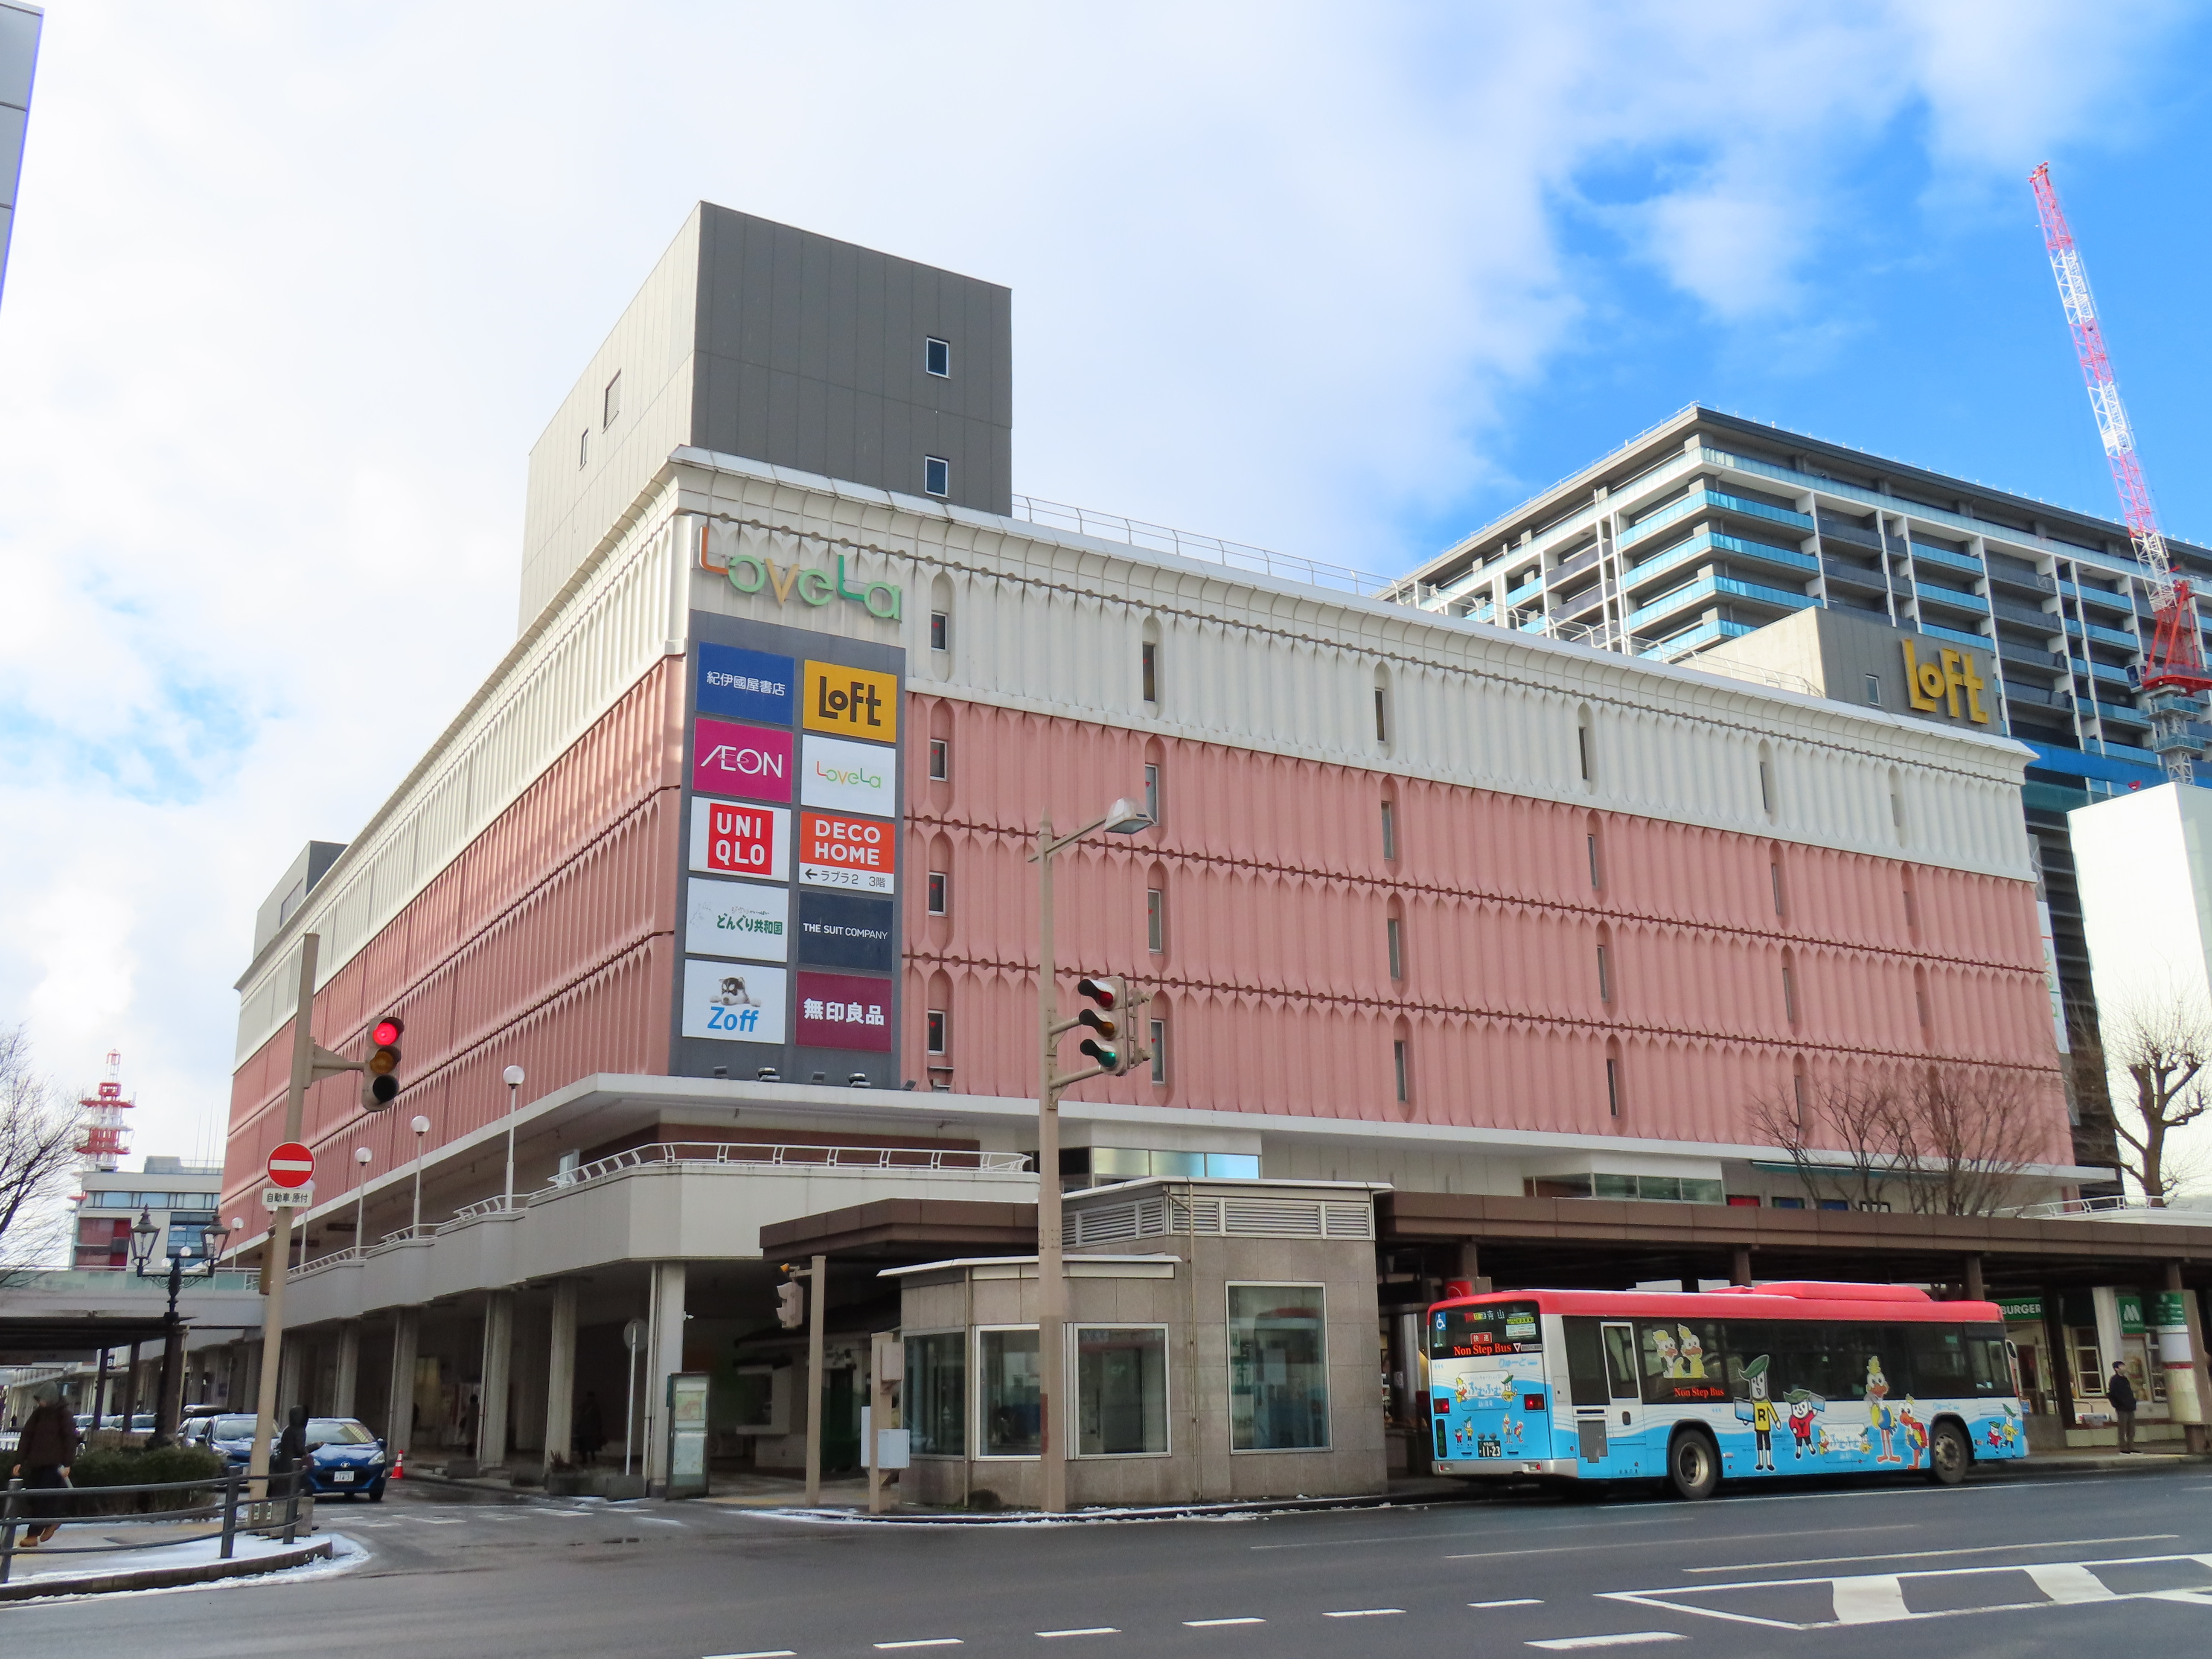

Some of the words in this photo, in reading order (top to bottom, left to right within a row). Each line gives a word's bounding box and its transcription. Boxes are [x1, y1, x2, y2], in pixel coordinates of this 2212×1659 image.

[700, 527, 902, 620] LoveLa
[706, 670, 786, 696] 紀伊國屋書店
[816, 761, 881, 789] LoveLa
[717, 812, 761, 839] UNI
[815, 820, 881, 844] DECO
[716, 840, 765, 866] QLO
[815, 841, 880, 866] HOME
[821, 870, 859, 885] ラブラ2
[869, 876, 886, 888] 3階
[717, 913, 783, 935] どんぐり共和国
[803, 923, 821, 933] THE
[824, 925, 844, 936] SUIT
[845, 927, 888, 940] COMPANY
[707, 1006, 759, 1032] Zoff
[803, 998, 885, 1026] 無印良品
[1453, 1346, 1472, 1356] Non
[1473, 1344, 1493, 1356] Step
[1494, 1343, 1511, 1353] Bus
[1674, 1387, 1691, 1397] Non
[1691, 1387, 1708, 1399] Step
[1710, 1386, 1725, 1396] Bus
